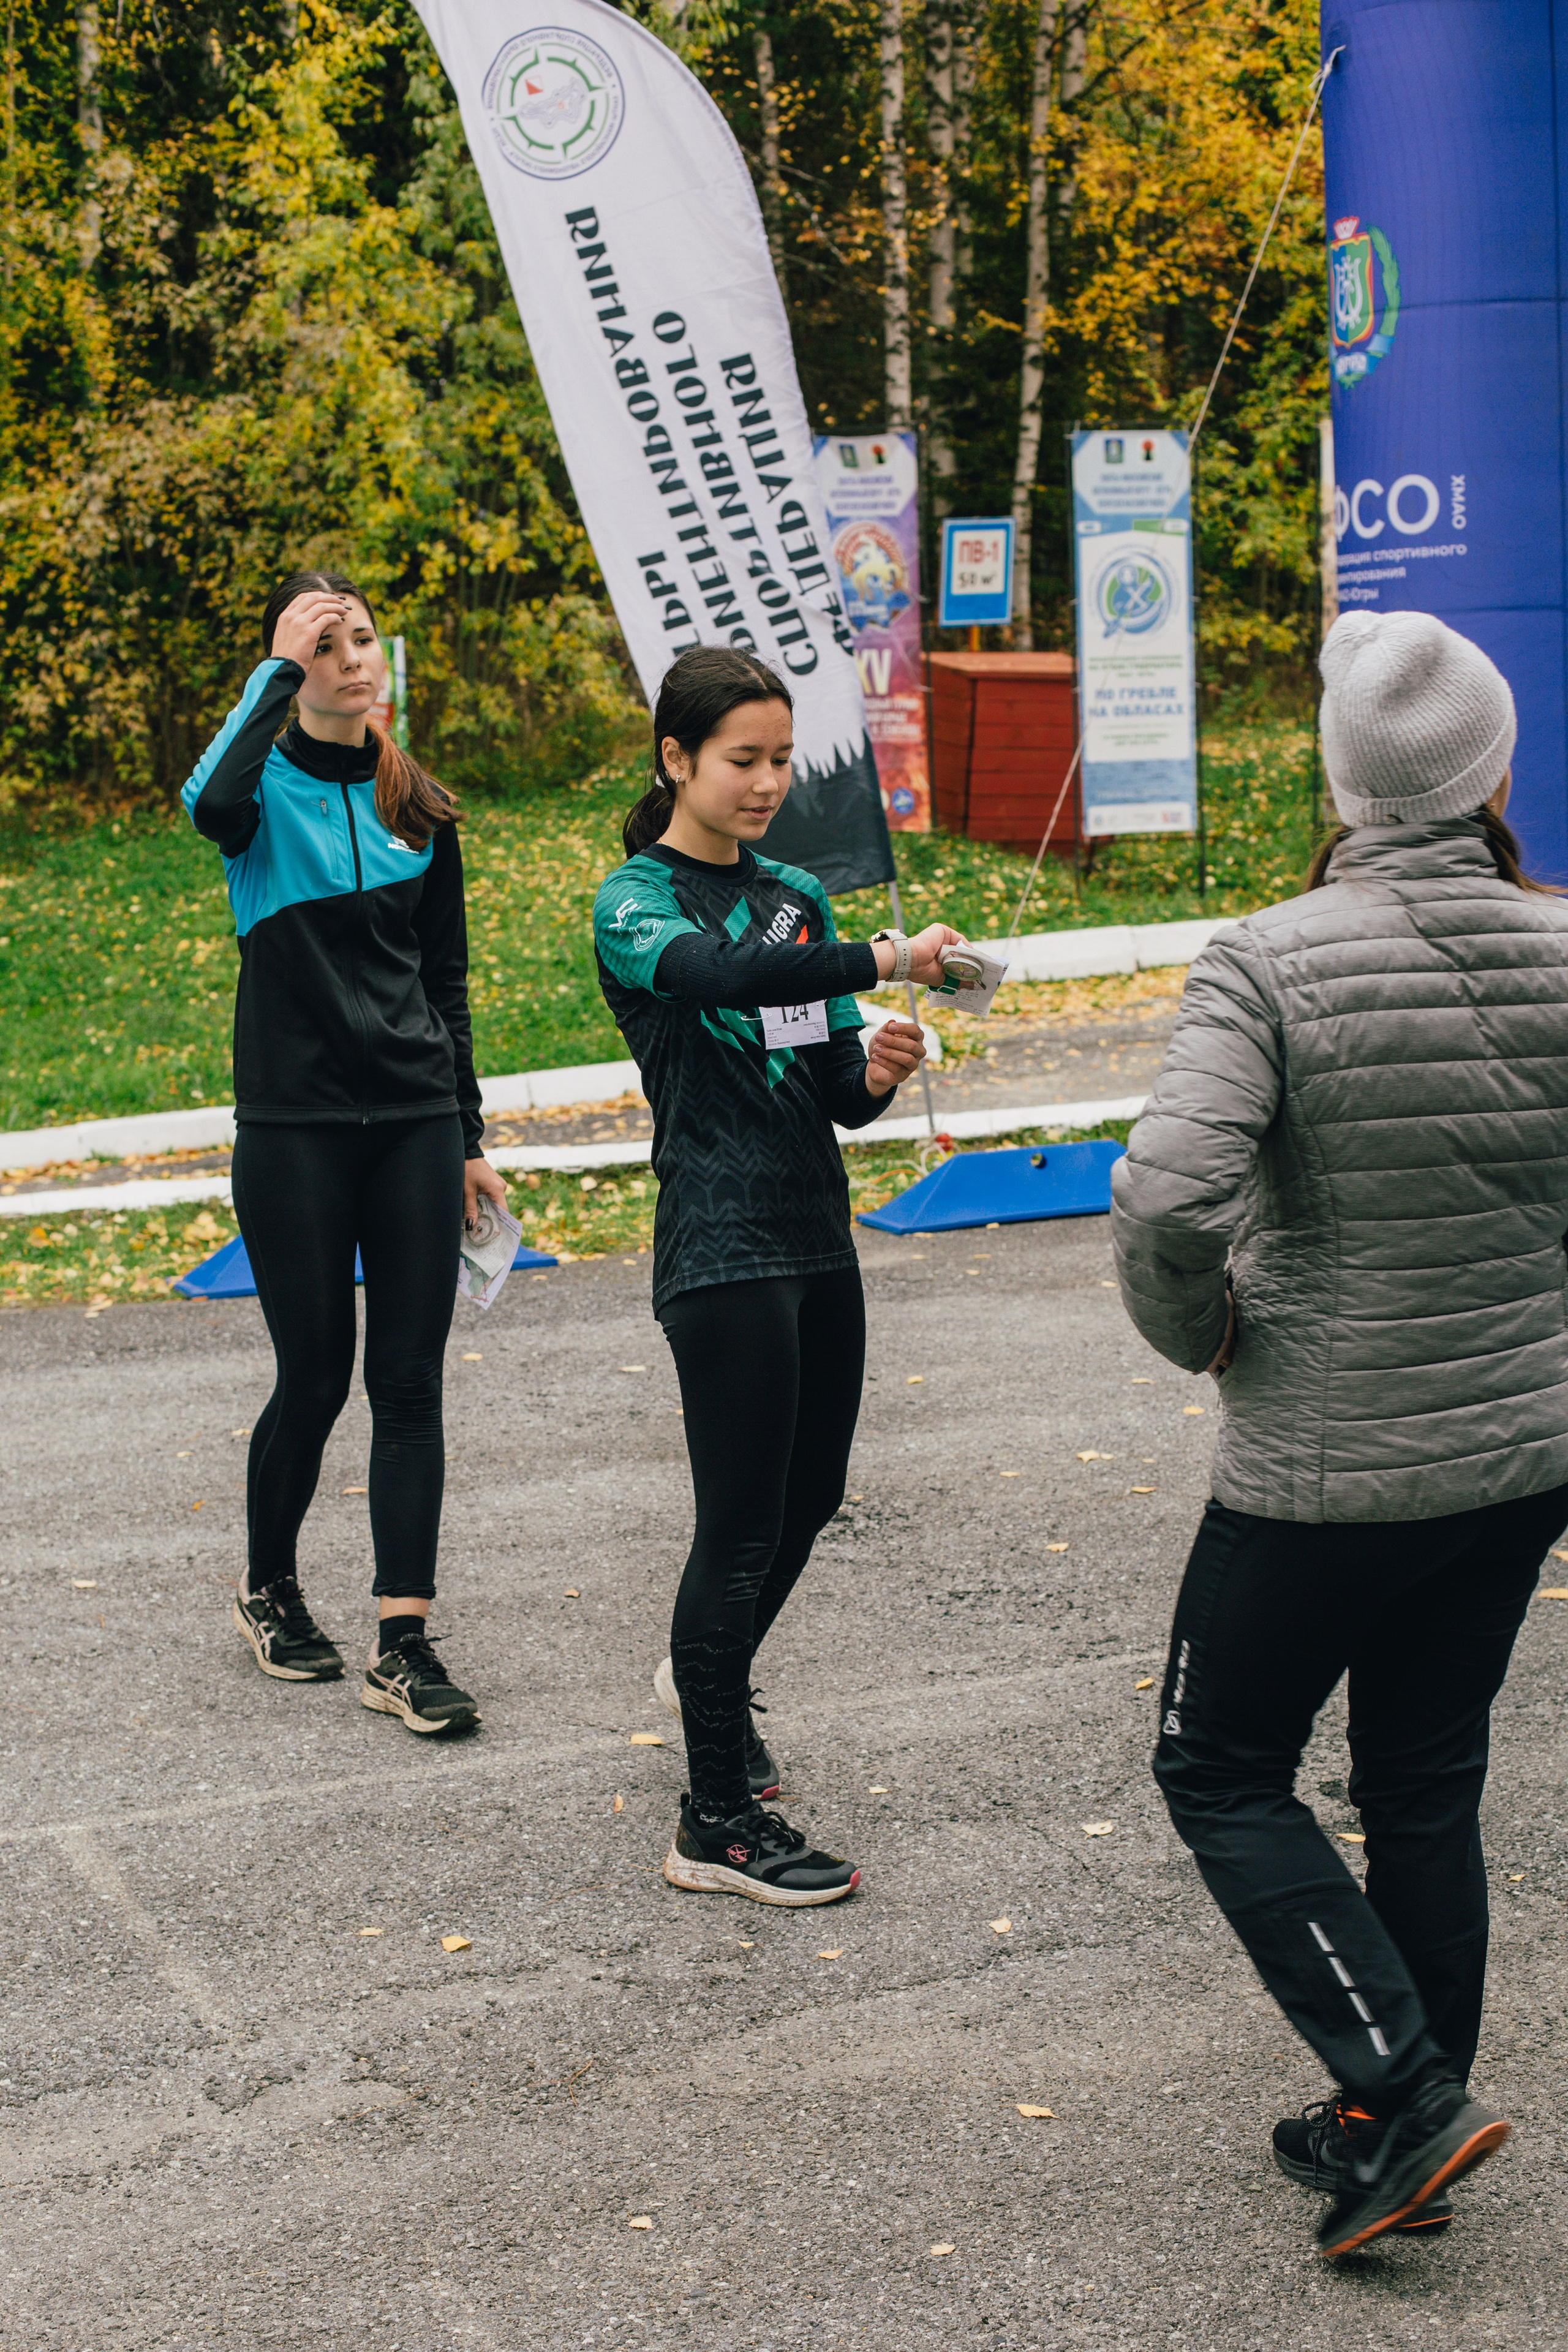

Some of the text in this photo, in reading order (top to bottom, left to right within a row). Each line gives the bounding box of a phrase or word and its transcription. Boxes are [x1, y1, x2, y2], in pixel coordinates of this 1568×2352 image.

[1450, 474, 1467, 530] ХМАО
[1373, 544, 1468, 563] спортивного
[782, 1005, 809, 1024] 124
